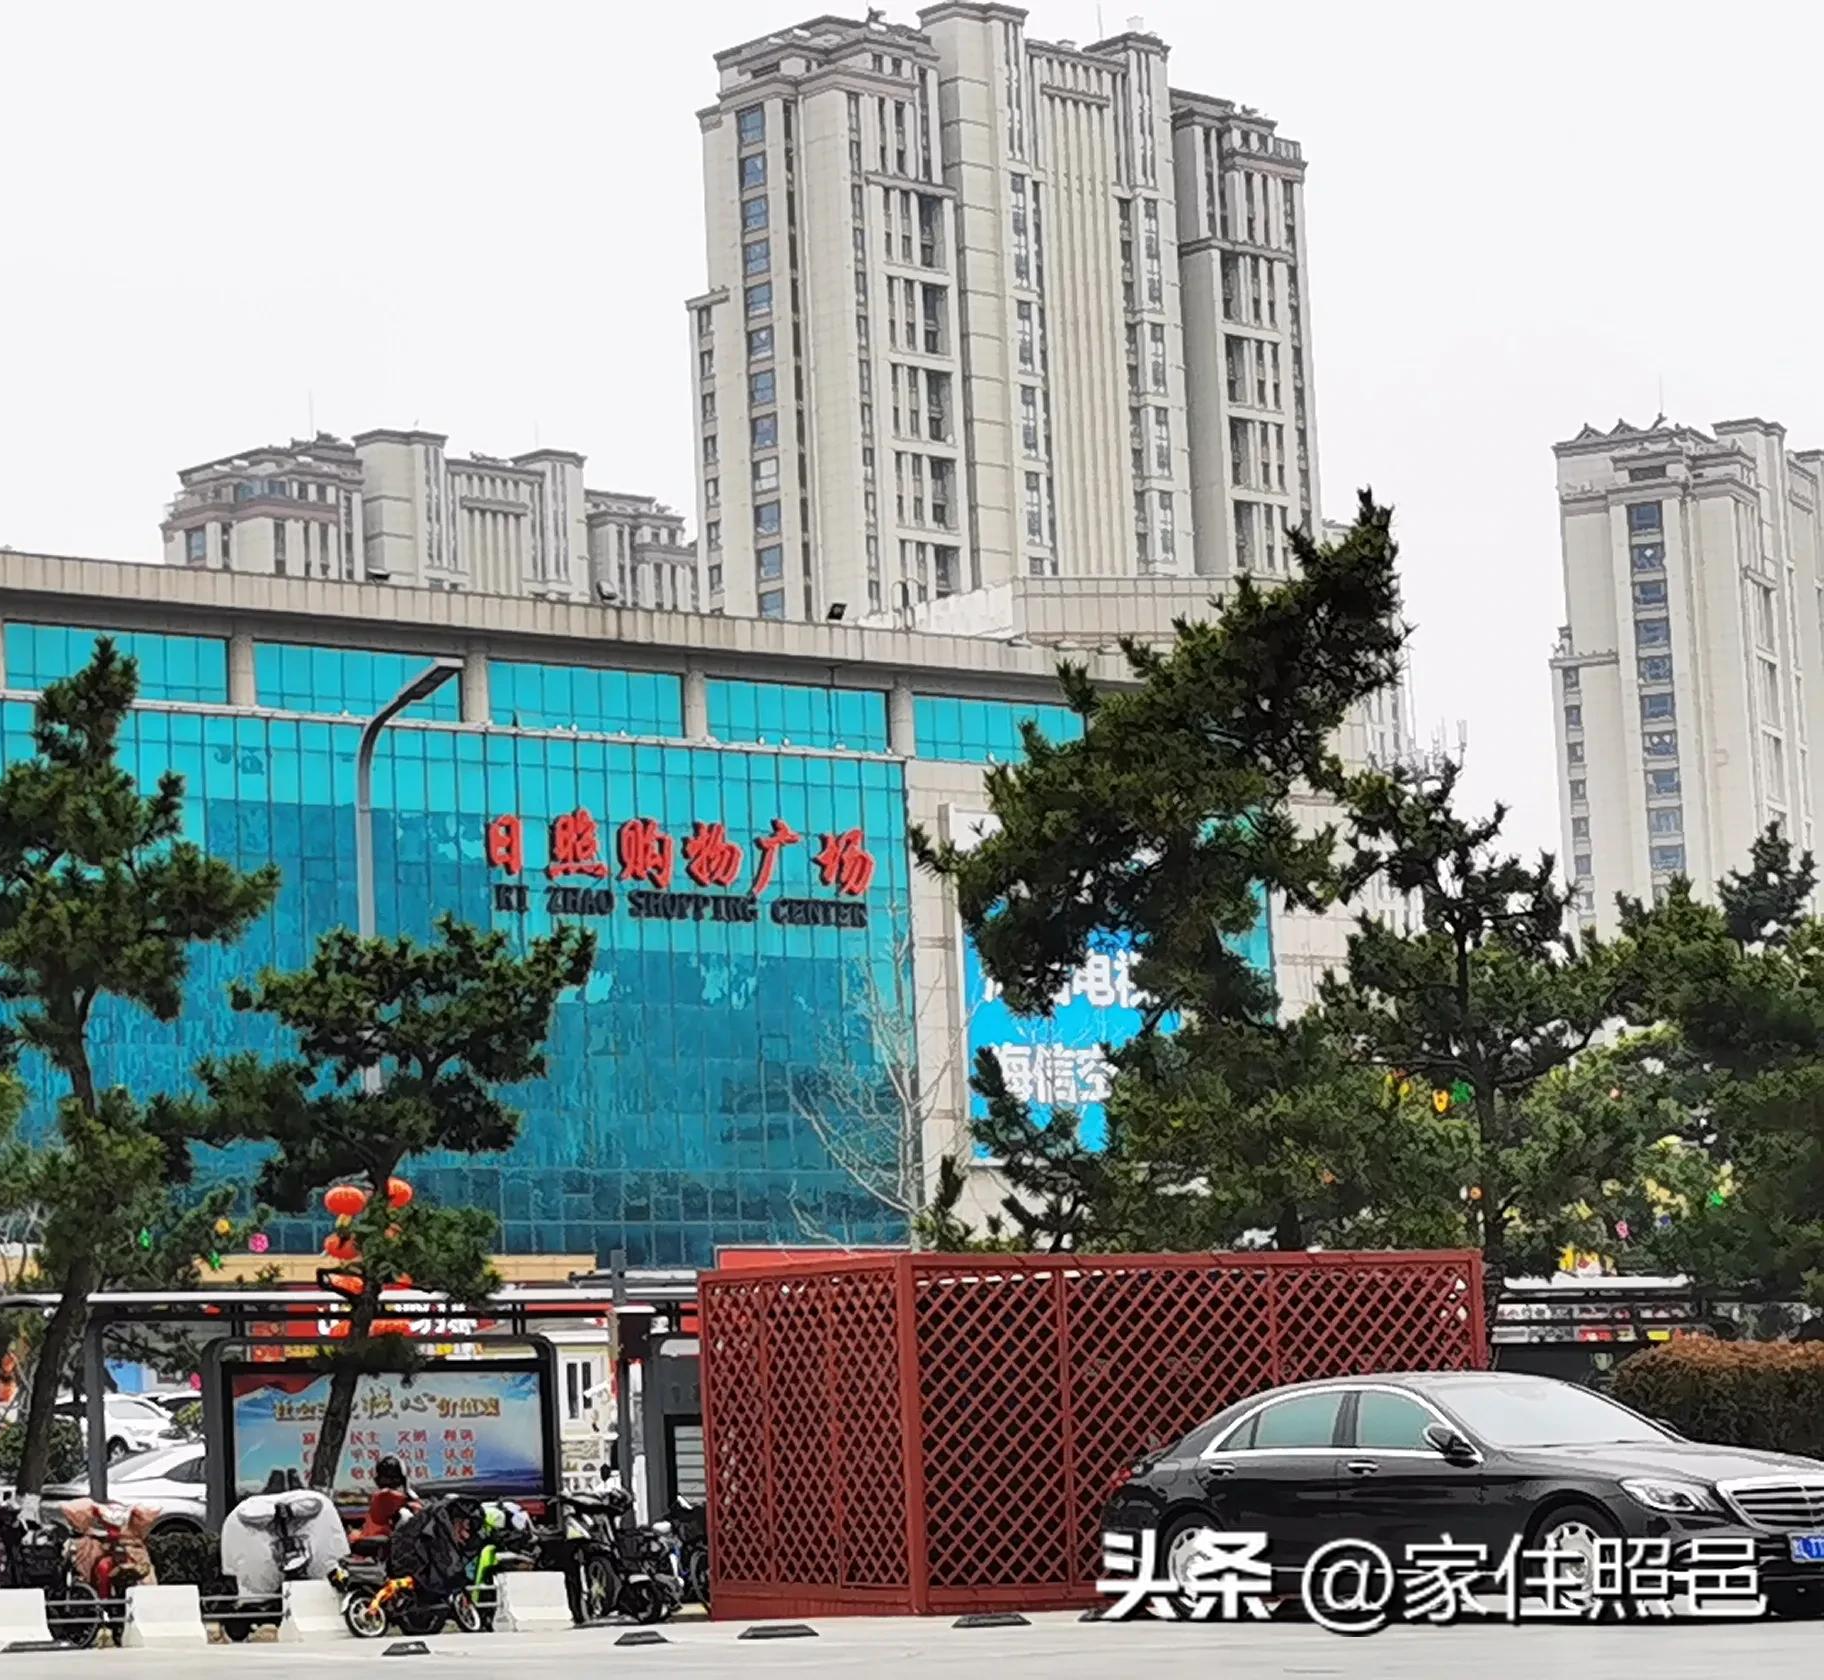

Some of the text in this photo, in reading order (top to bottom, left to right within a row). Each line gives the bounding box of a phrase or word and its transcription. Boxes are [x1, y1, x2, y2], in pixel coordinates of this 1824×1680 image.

[487, 806, 875, 898] 日照购物广场
[493, 883, 869, 928] RI ZHAO SHOPPING CENTER
